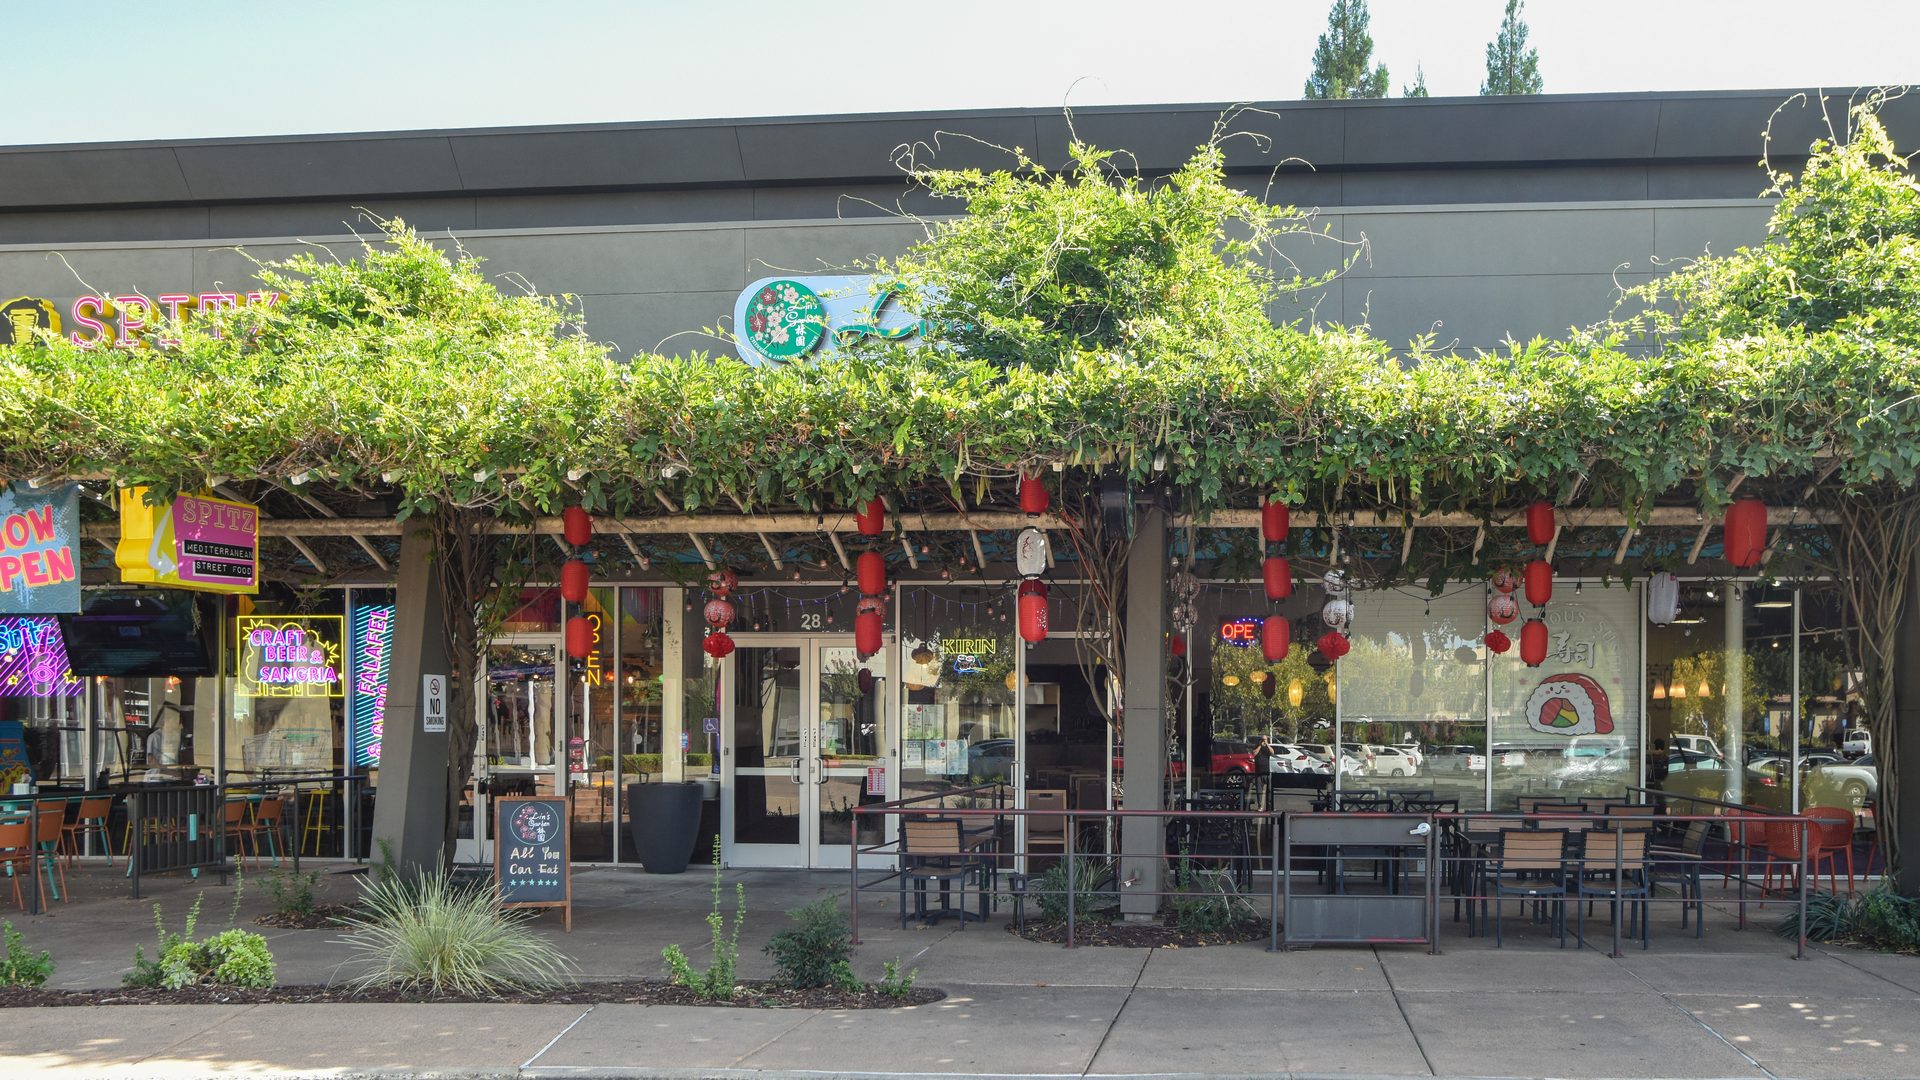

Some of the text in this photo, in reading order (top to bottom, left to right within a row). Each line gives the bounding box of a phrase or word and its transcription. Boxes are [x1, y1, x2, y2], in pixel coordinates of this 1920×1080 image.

[183, 498, 254, 533] SPITZ
[0, 504, 56, 552] OW
[187, 543, 254, 559] MEDITERRANEAN
[0, 547, 76, 593] PEN
[196, 562, 252, 575] STREET FOOD
[800, 613, 821, 629] 28
[250, 629, 306, 647] CRAFT
[1221, 623, 1255, 640] OPE
[265, 645, 324, 665] BEER &
[357, 608, 390, 697] FALAFEL
[942, 638, 996, 655] KIRIN
[259, 666, 338, 684] SANGRIA
[430, 698, 441, 715] NO
[425, 716, 445, 726] SMOKING
[529, 811, 551, 821] Lin's
[528, 820, 551, 831] Garden
[542, 846, 560, 860] You
[509, 863, 559, 875] Can Eat
